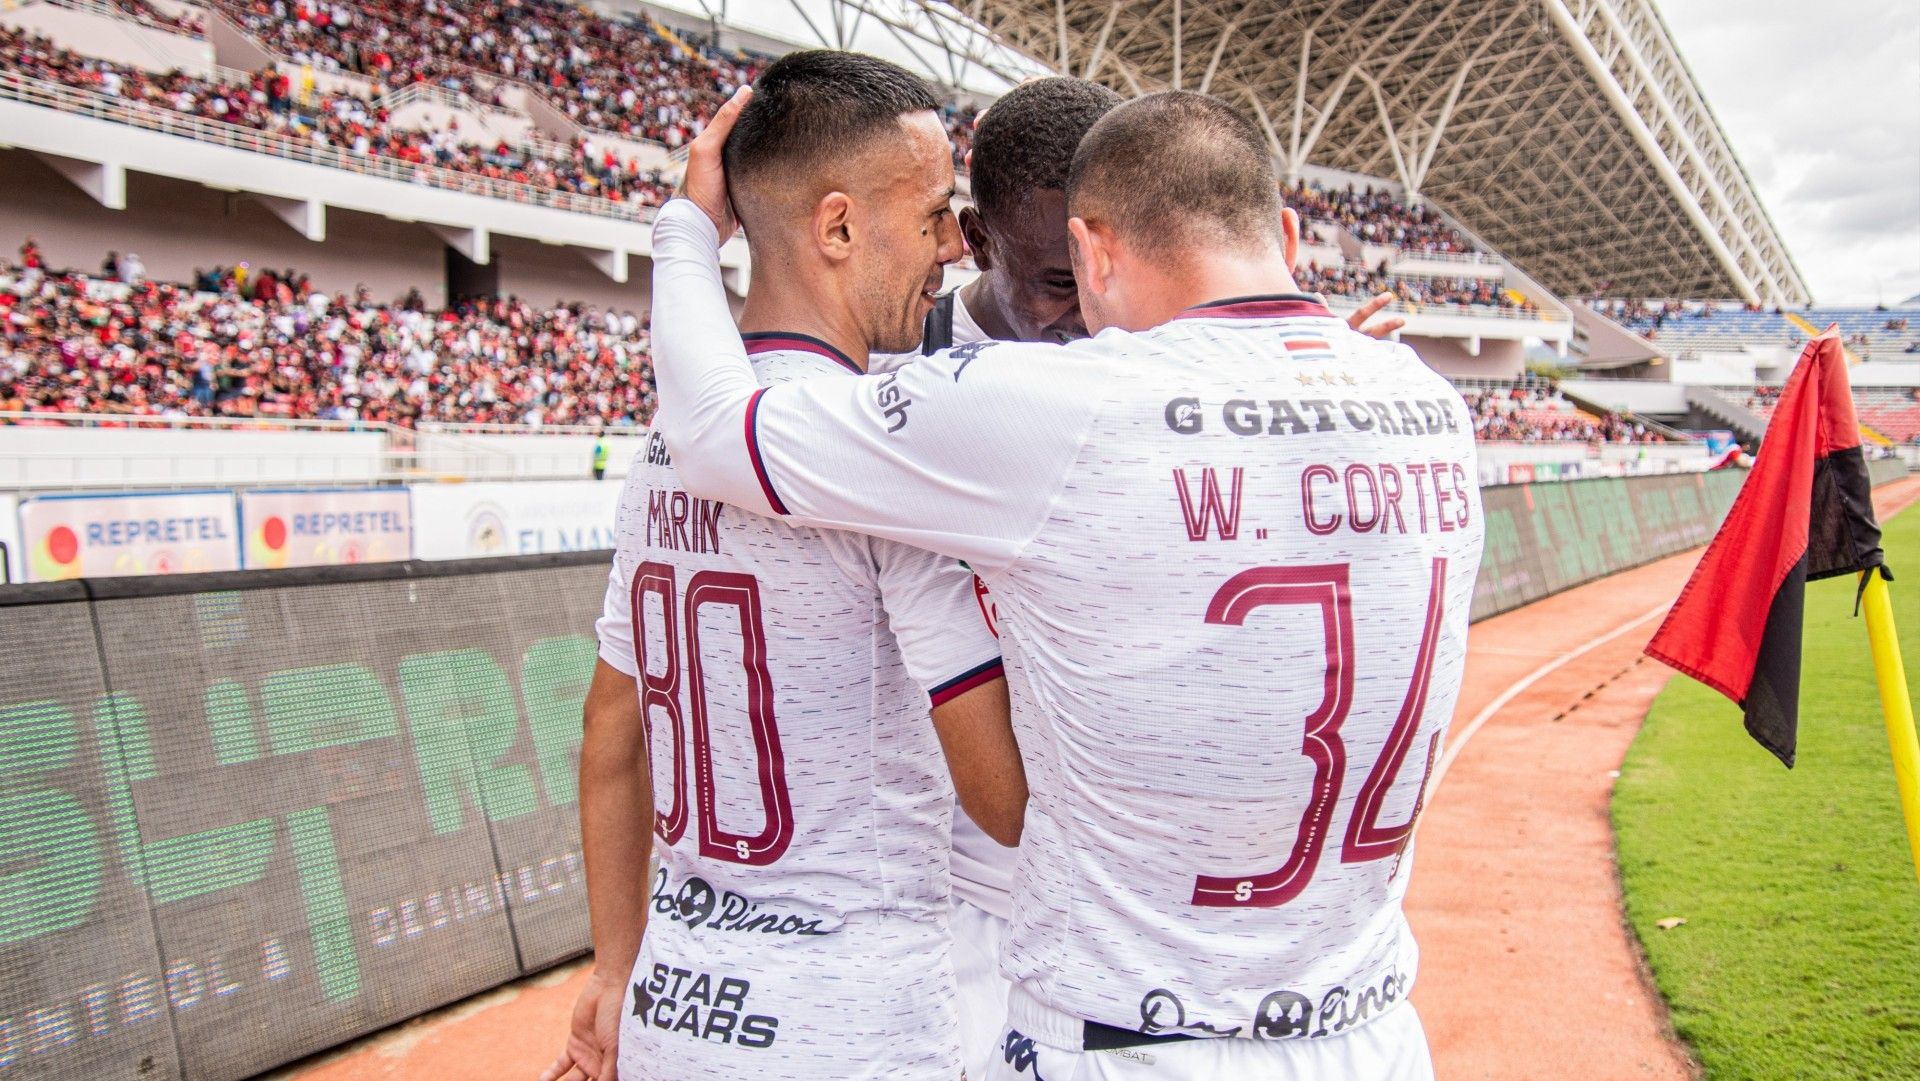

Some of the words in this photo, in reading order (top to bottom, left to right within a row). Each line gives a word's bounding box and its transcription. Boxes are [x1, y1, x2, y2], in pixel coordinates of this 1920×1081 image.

[1223, 398, 1460, 436] GATORADE
[293, 510, 404, 536] REPRETEL
[646, 489, 724, 554] MARIN
[1173, 467, 1268, 541] W.
[1301, 462, 1469, 535] CORTES
[86, 517, 228, 546] REPRETEL
[631, 561, 795, 866] 80
[1191, 557, 1447, 908] 34
[648, 963, 750, 1010] STAR
[653, 997, 779, 1048] CARS
